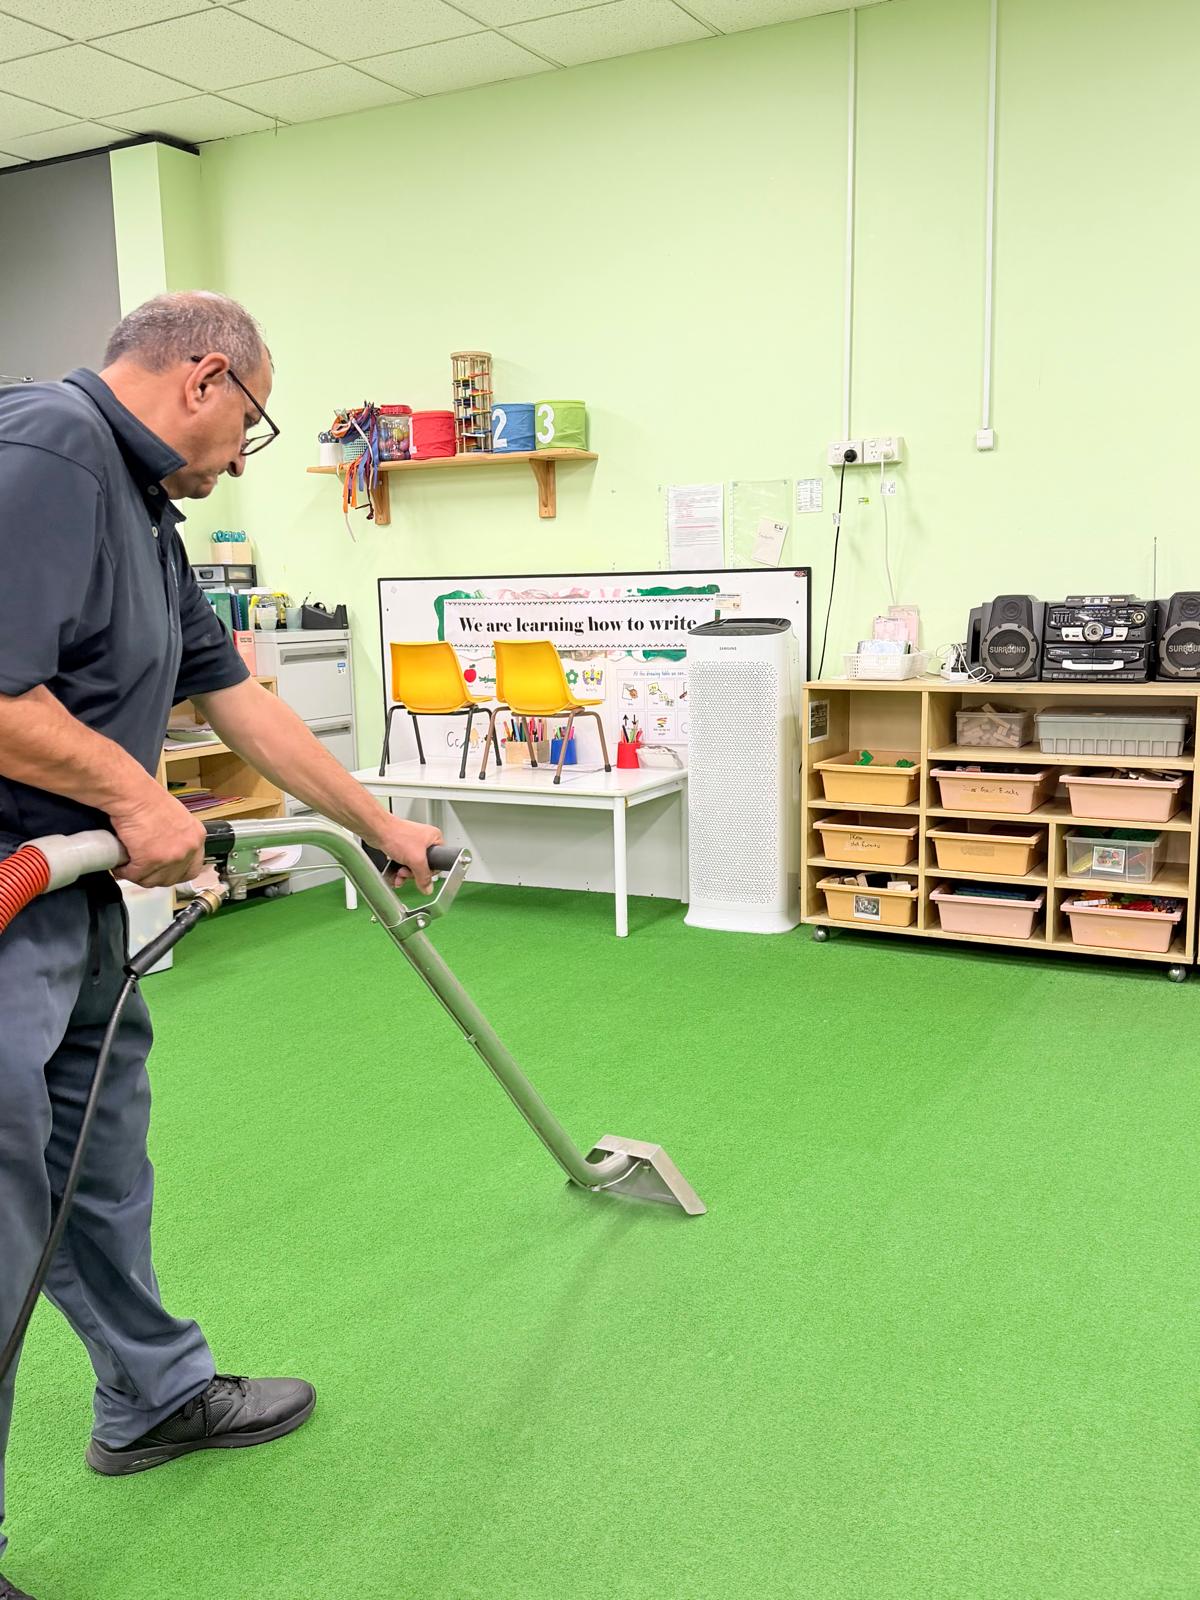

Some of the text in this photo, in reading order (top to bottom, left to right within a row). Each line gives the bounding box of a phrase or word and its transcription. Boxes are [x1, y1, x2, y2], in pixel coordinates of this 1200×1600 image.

[492, 408, 508, 448] 2
[537, 403, 555, 444] 3
[459, 614, 698, 636] We are learning how to write
[989, 645, 1026, 654] SURROUND
